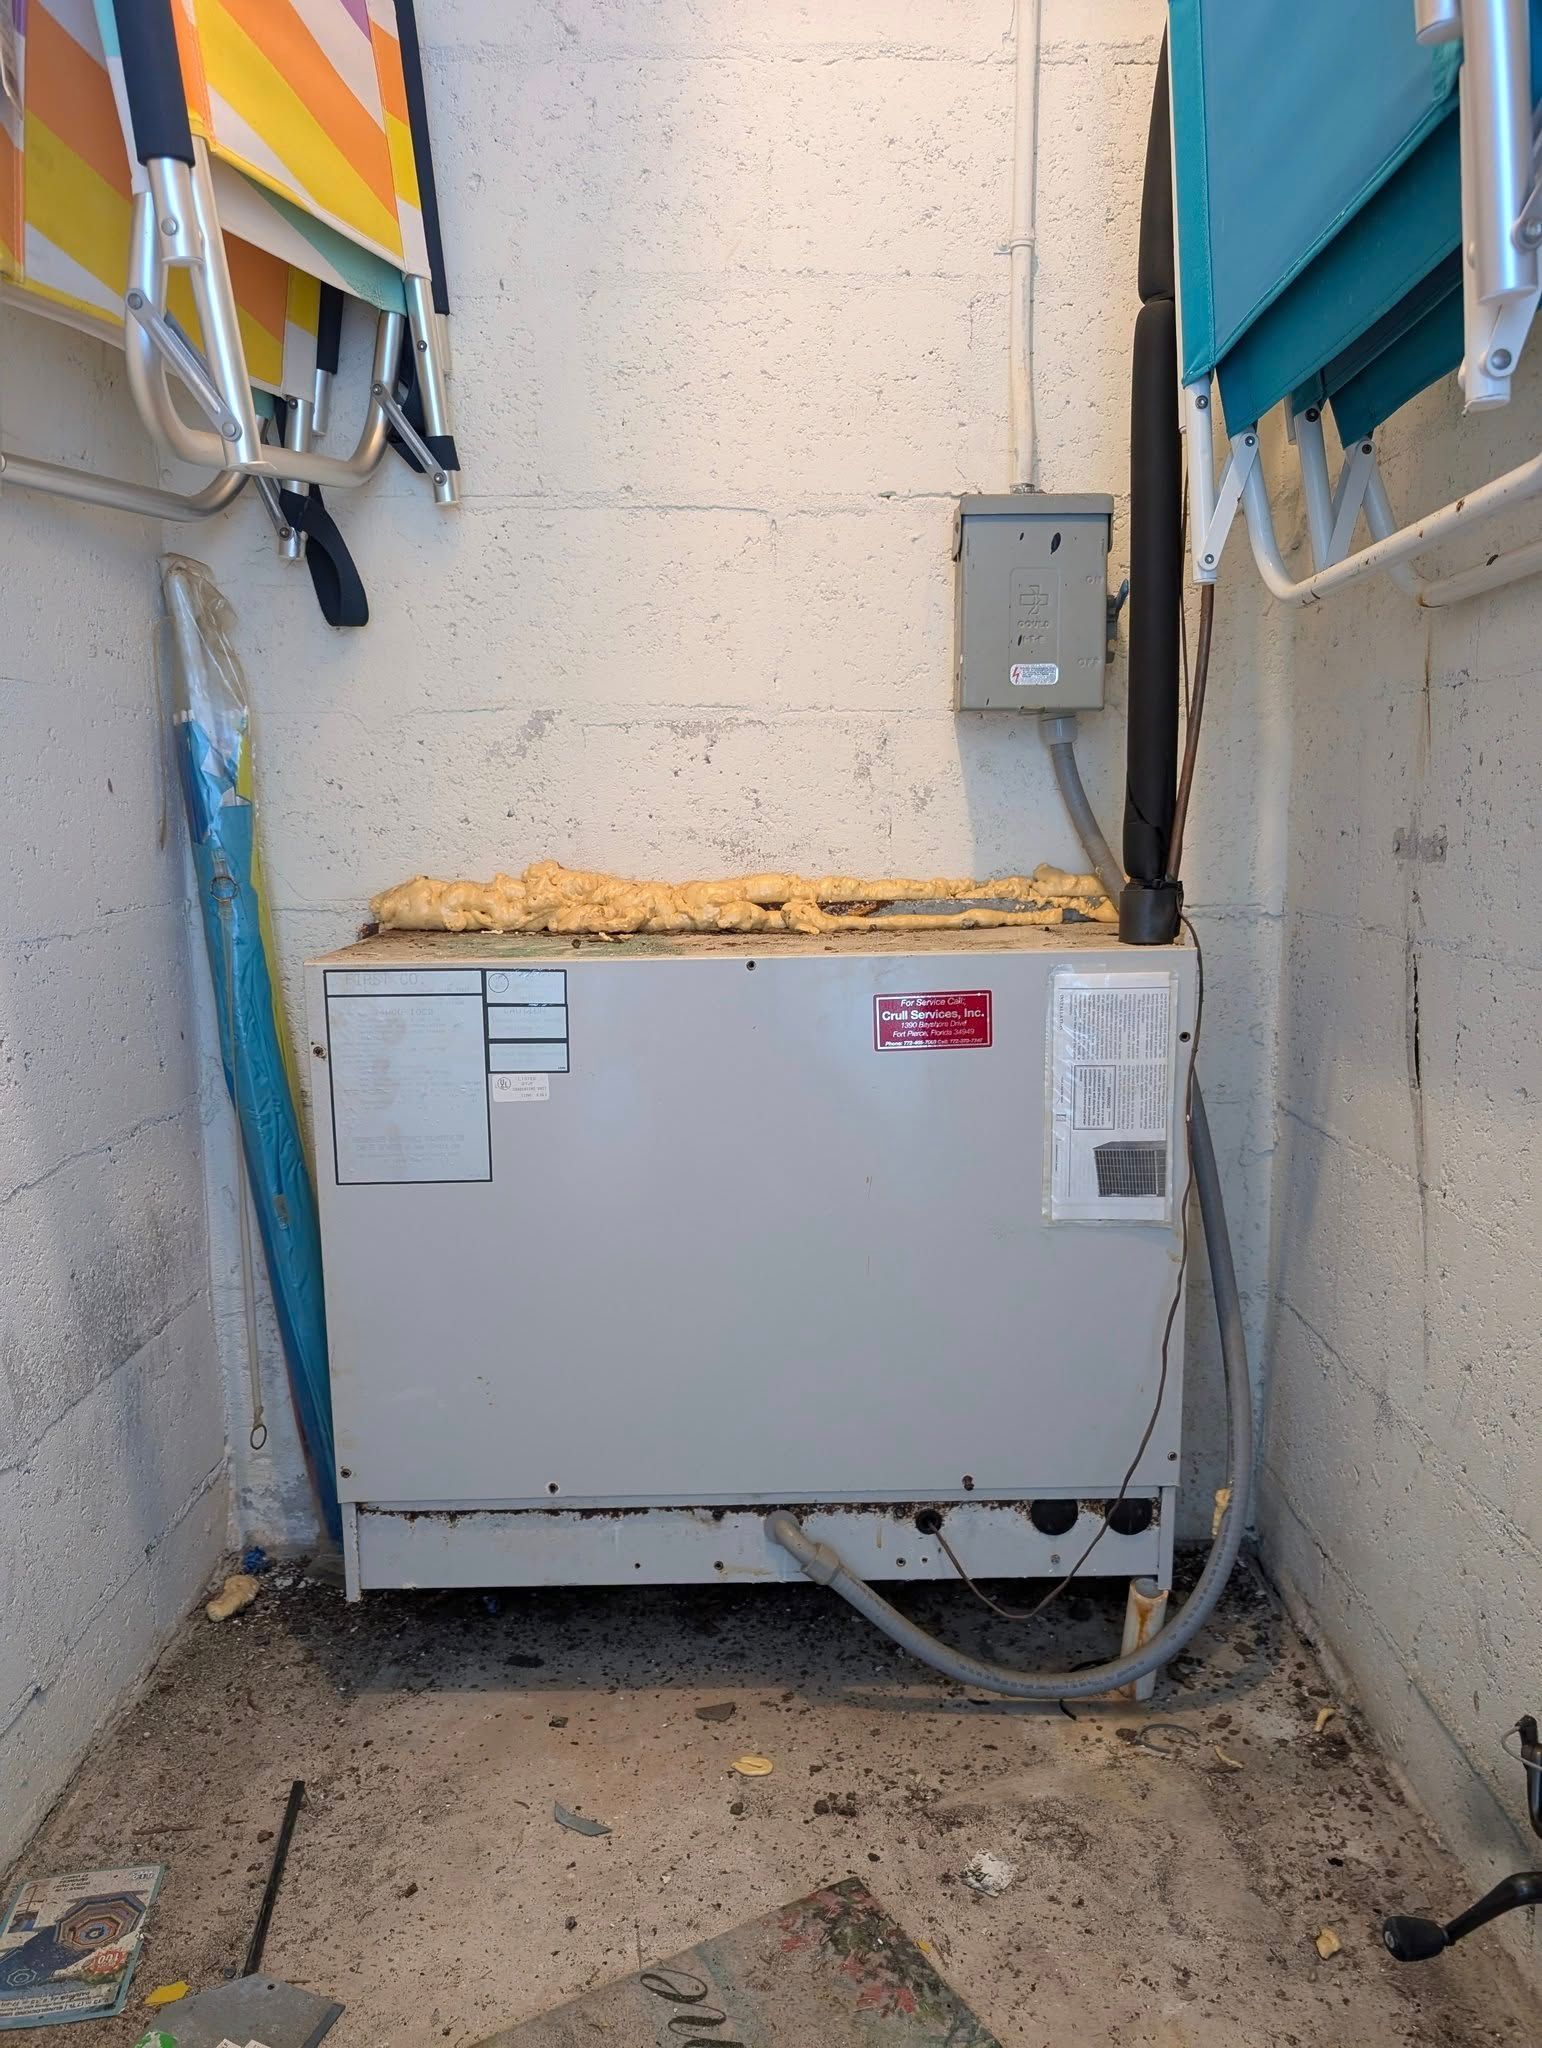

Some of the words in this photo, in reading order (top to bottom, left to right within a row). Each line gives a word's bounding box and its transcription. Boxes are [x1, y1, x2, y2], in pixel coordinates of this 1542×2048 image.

[344, 973, 389, 986] FIRST
[399, 973, 425, 986] CO.
[900, 999, 915, 1007] For
[916, 998, 946, 1007] Service
[882, 1011, 908, 1021] Crull
[910, 1008, 961, 1020] Services,
[963, 1007, 985, 1018] Inc.
[901, 1021, 918, 1029] 1390
[918, 1020, 950, 1030] Bayshore
[950, 1019, 968, 1028] Drive
[892, 1030, 907, 1039] Fort
[930, 1028, 953, 1037] Florida
